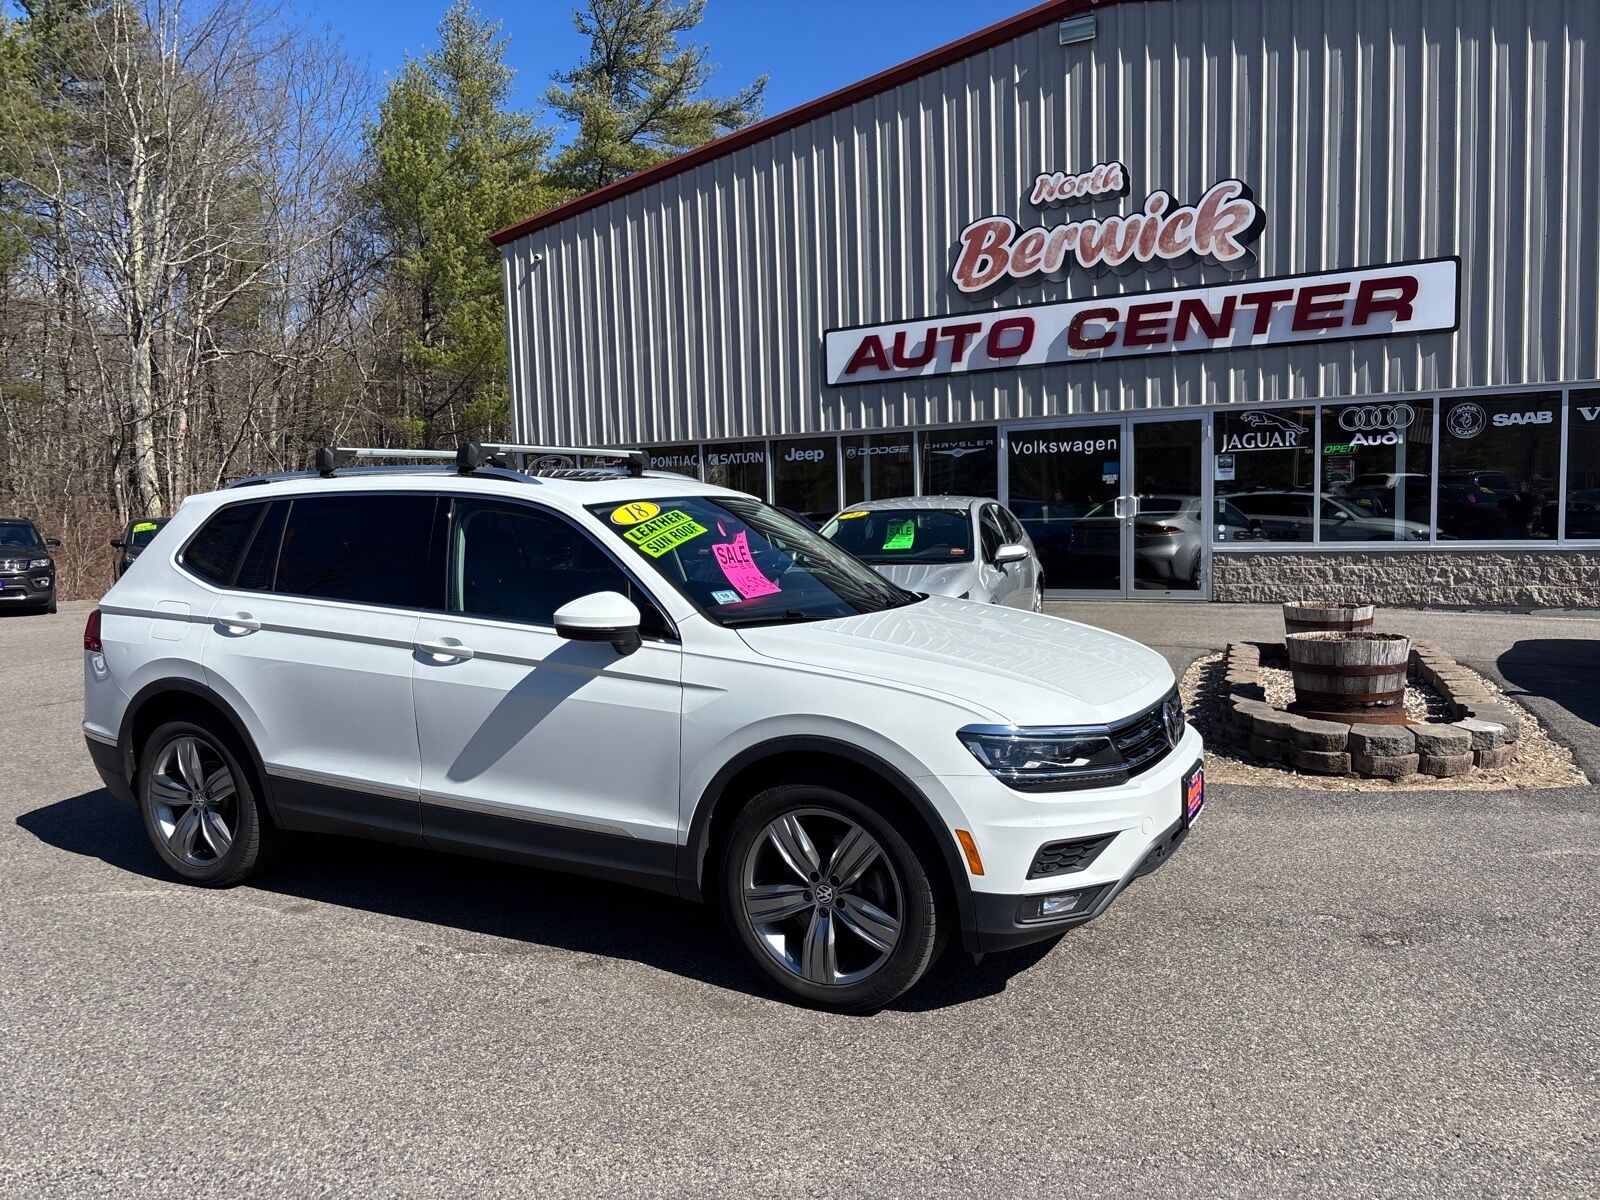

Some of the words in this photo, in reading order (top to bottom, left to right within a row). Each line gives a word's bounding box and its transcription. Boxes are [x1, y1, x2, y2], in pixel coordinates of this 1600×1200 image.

[1032, 163, 1122, 203] North
[954, 182, 1253, 290] Berwick
[844, 317, 1035, 375] AUTO
[1067, 275, 1420, 350] CENTER
[1492, 410, 1553, 427] SAAB
[924, 439, 994, 450] CHRYSLER
[1011, 438, 1117, 455] Volkswagen
[1220, 431, 1297, 453] JAGUAR
[1349, 431, 1404, 446] Audi
[720, 451, 764, 465] SATURN
[784, 447, 825, 462] Jeep
[857, 445, 910, 456] DODGE
[651, 455, 698, 468] PONTIAC
[623, 503, 650, 522] 18
[629, 512, 686, 541] LEATHER
[889, 526, 912, 536] SALE
[647, 534, 675, 553] SUN
[670, 523, 698, 541] ROOF
[716, 545, 750, 565] SALE
